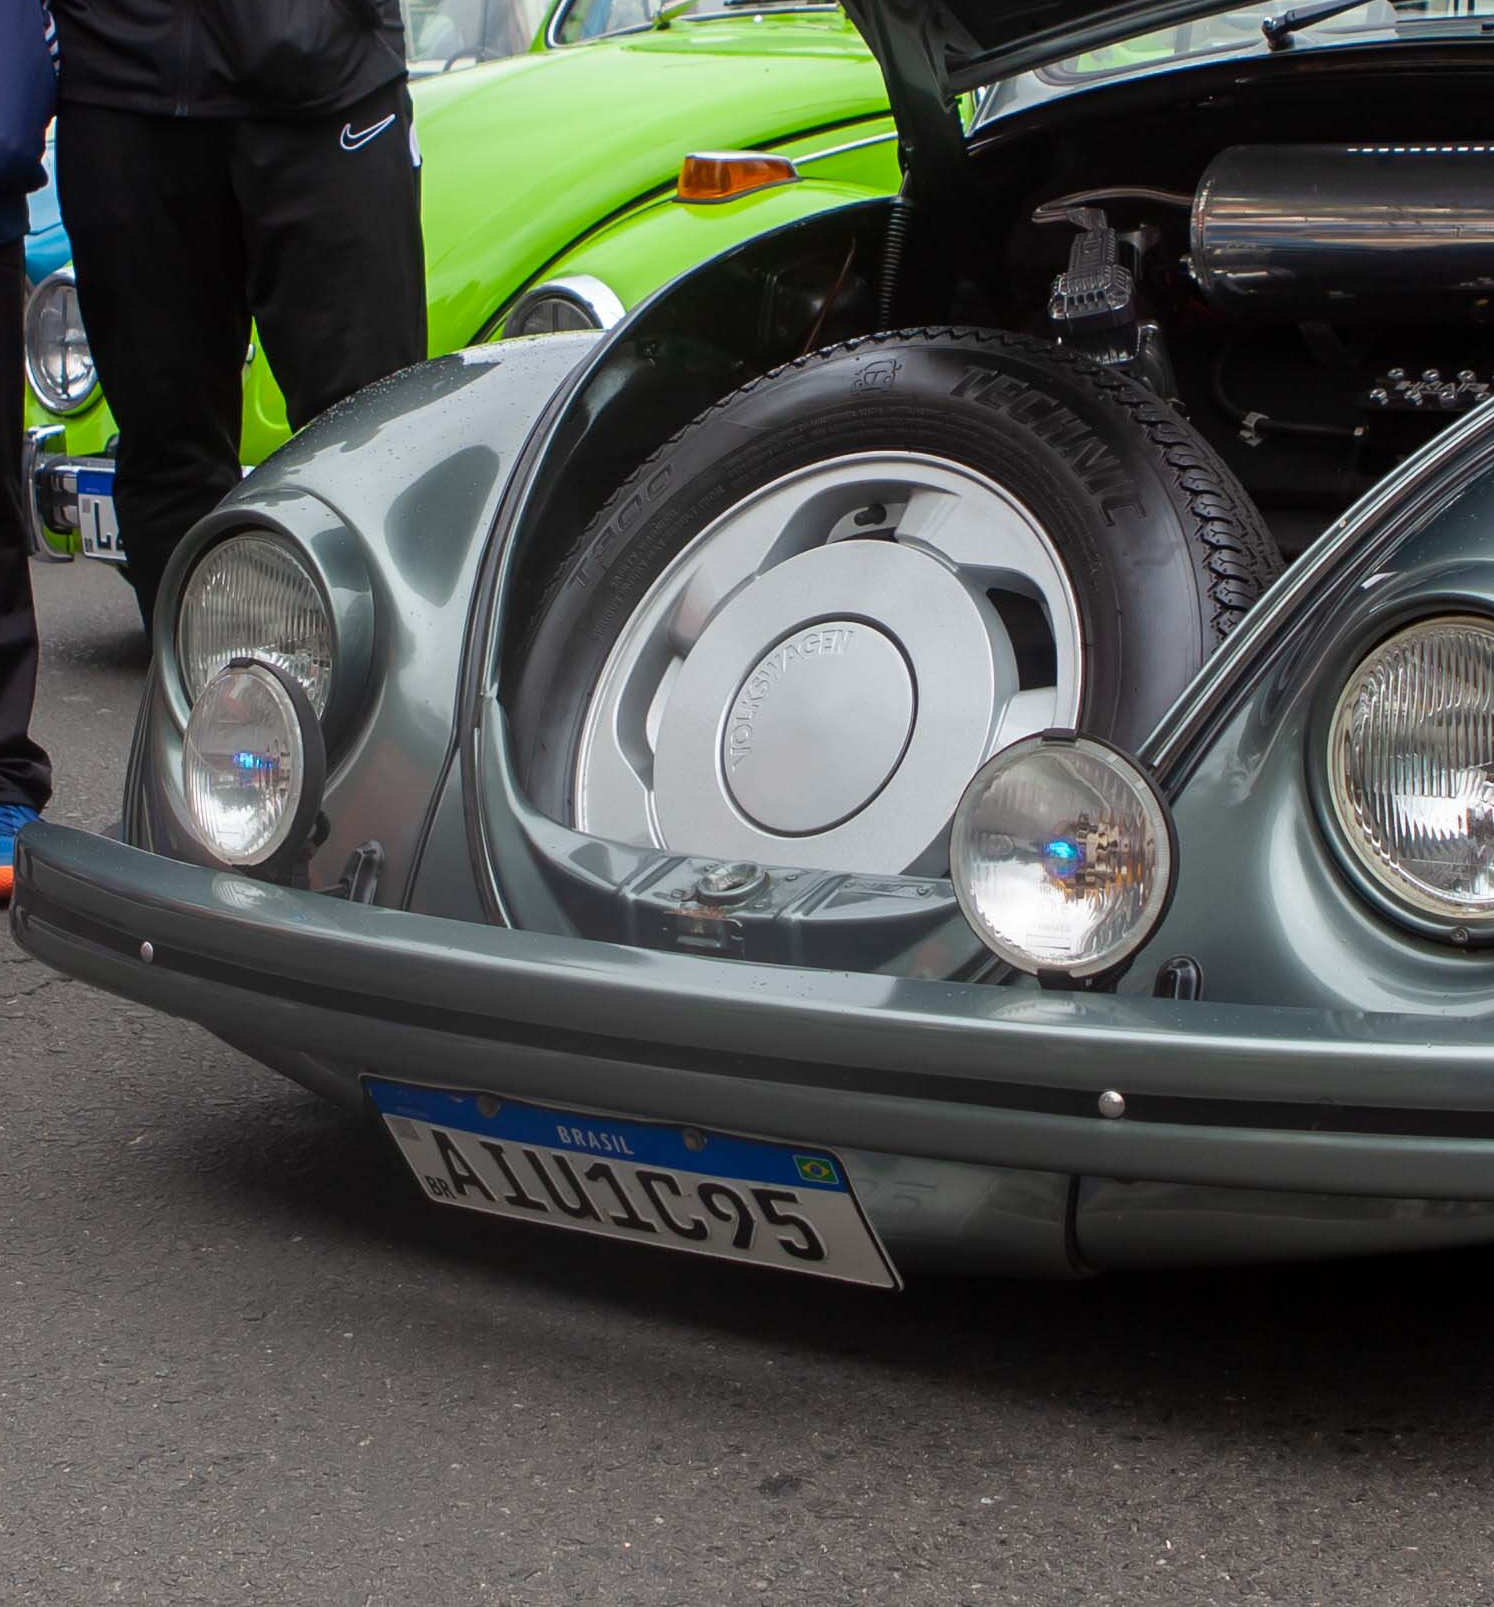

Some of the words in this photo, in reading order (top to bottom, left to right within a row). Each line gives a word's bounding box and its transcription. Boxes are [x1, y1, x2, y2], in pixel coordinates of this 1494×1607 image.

[729, 628, 855, 772] VOLKSWAGEN
[556, 1124, 635, 1156] BRASIL
[424, 1175, 457, 1200] BR
[430, 1128, 828, 1261] AIU1C95
